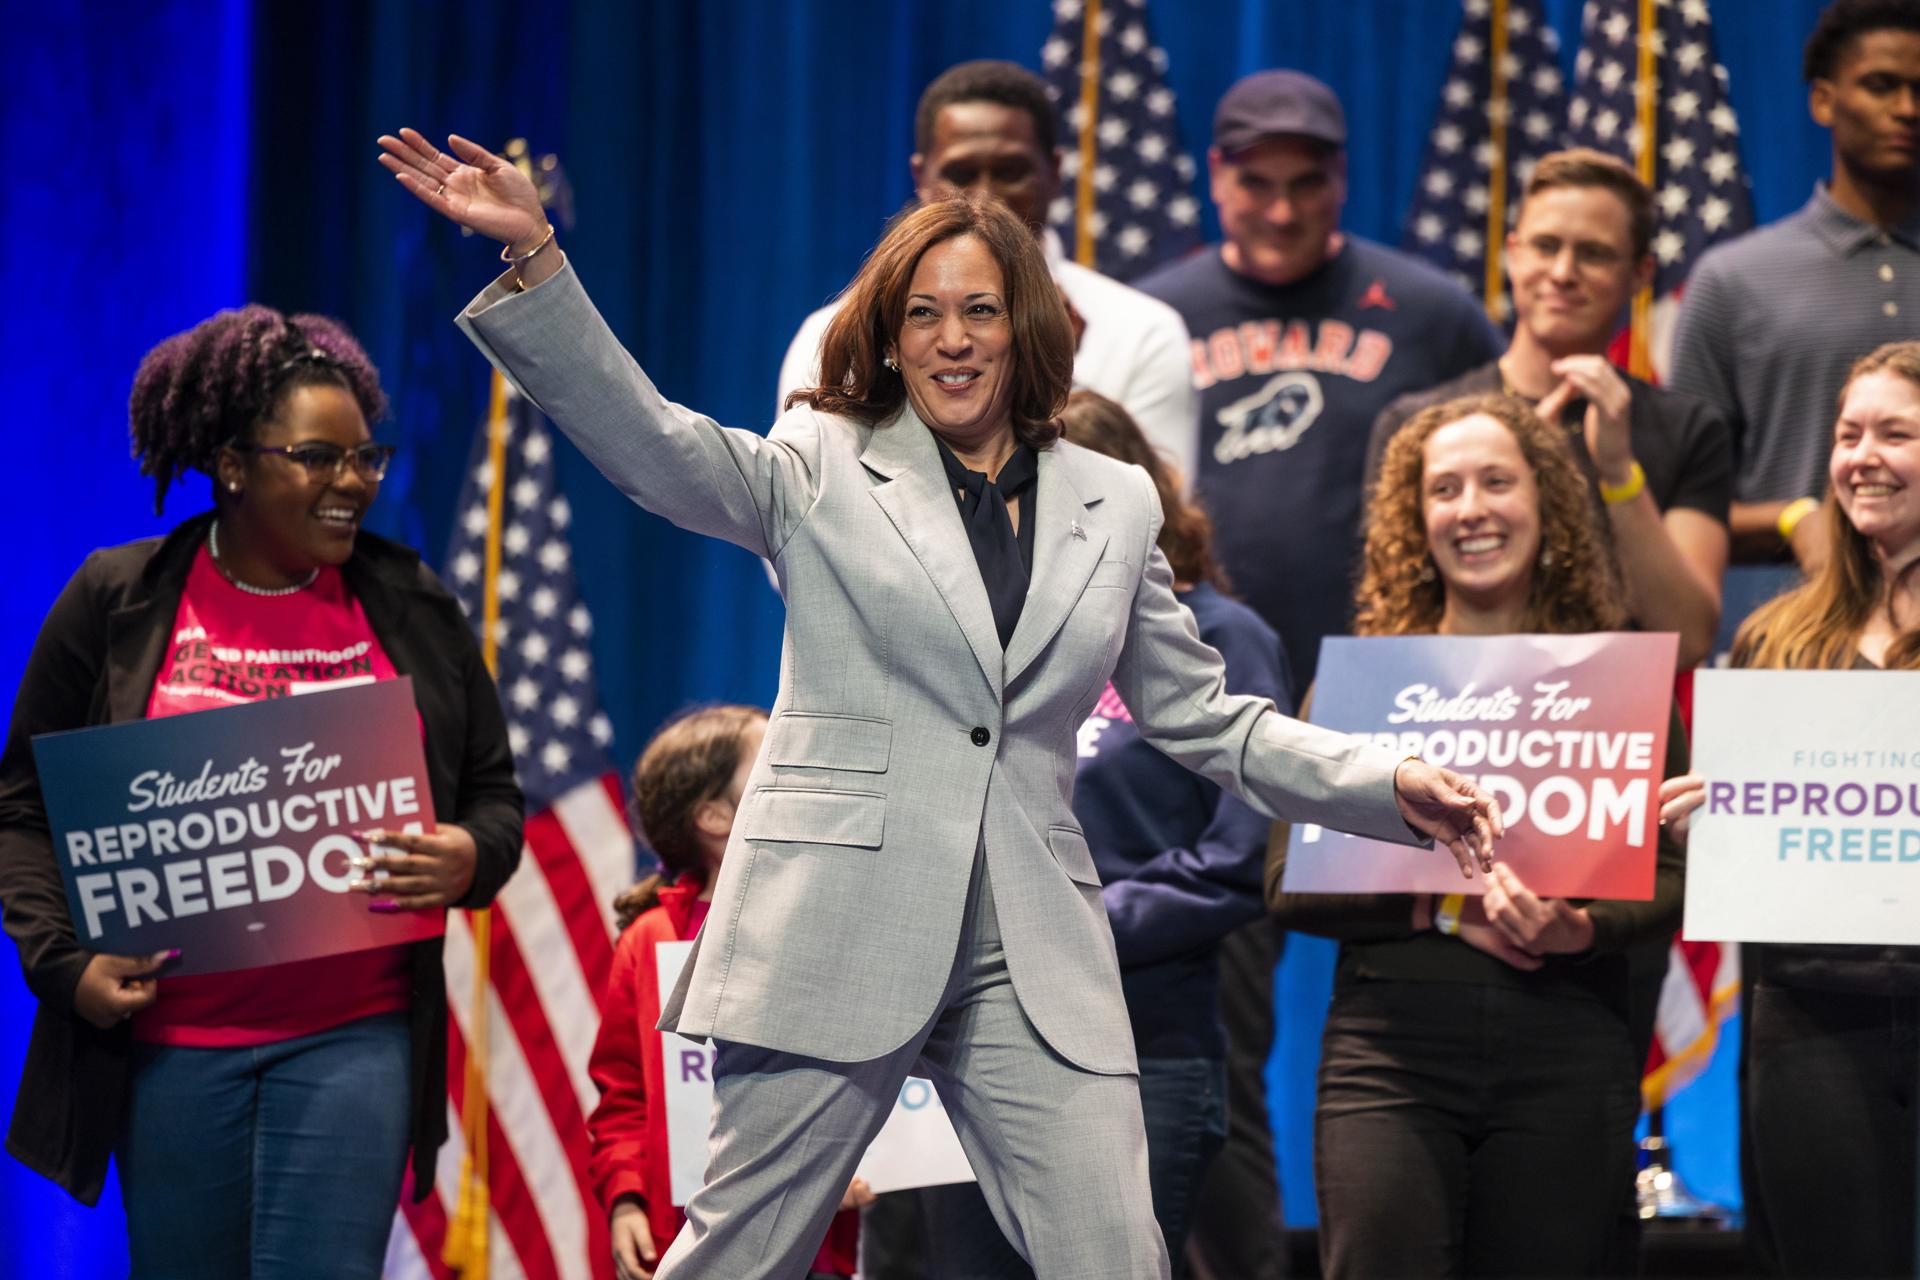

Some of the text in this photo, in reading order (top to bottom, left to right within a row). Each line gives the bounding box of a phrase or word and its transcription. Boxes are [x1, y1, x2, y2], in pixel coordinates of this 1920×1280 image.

[169, 664, 286, 699] ACTION
[1387, 680, 1591, 724] Students For
[128, 742, 342, 813] Students For
[65, 777, 420, 867] REPRODUCTIVE
